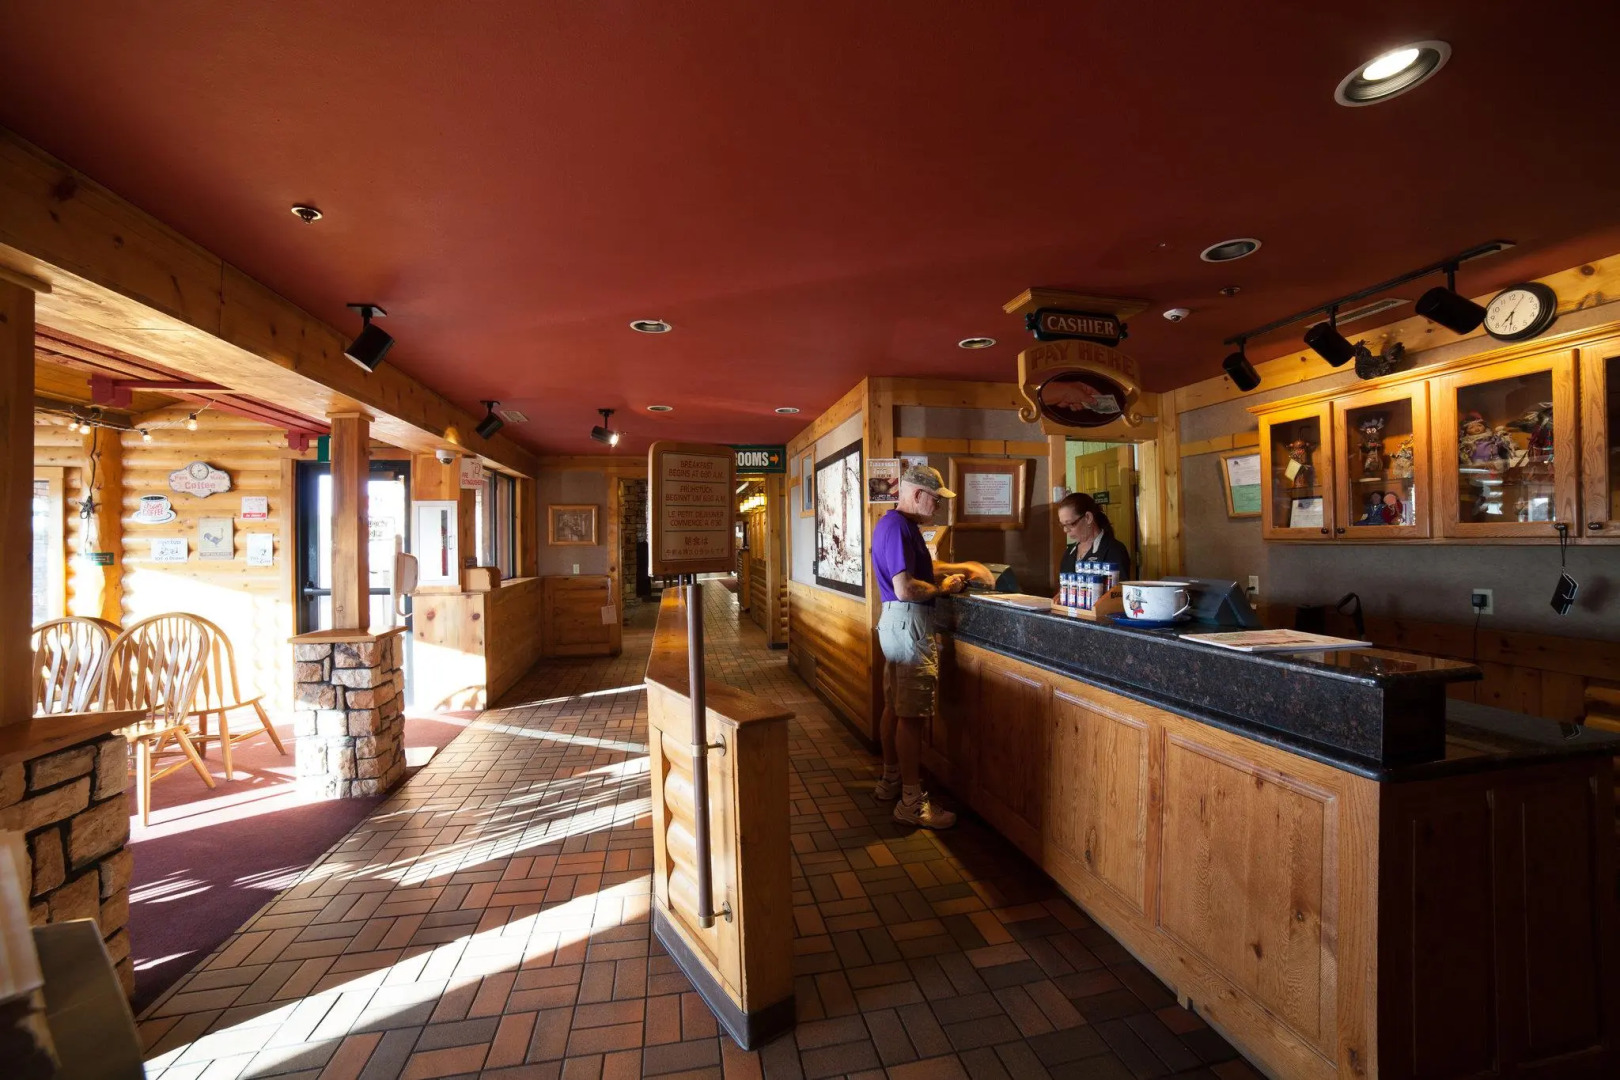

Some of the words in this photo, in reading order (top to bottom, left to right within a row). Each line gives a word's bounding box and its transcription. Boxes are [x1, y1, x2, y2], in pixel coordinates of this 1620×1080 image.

[1047, 316, 1115, 336] CASHIER
[1030, 341, 1069, 370] PAY
[1078, 342, 1137, 377] HERE
[680, 460, 714, 470] BREAKFAST
[736, 451, 769, 467] OOMS
[668, 468, 690, 478] BEGINS
[691, 471, 699, 479] AT
